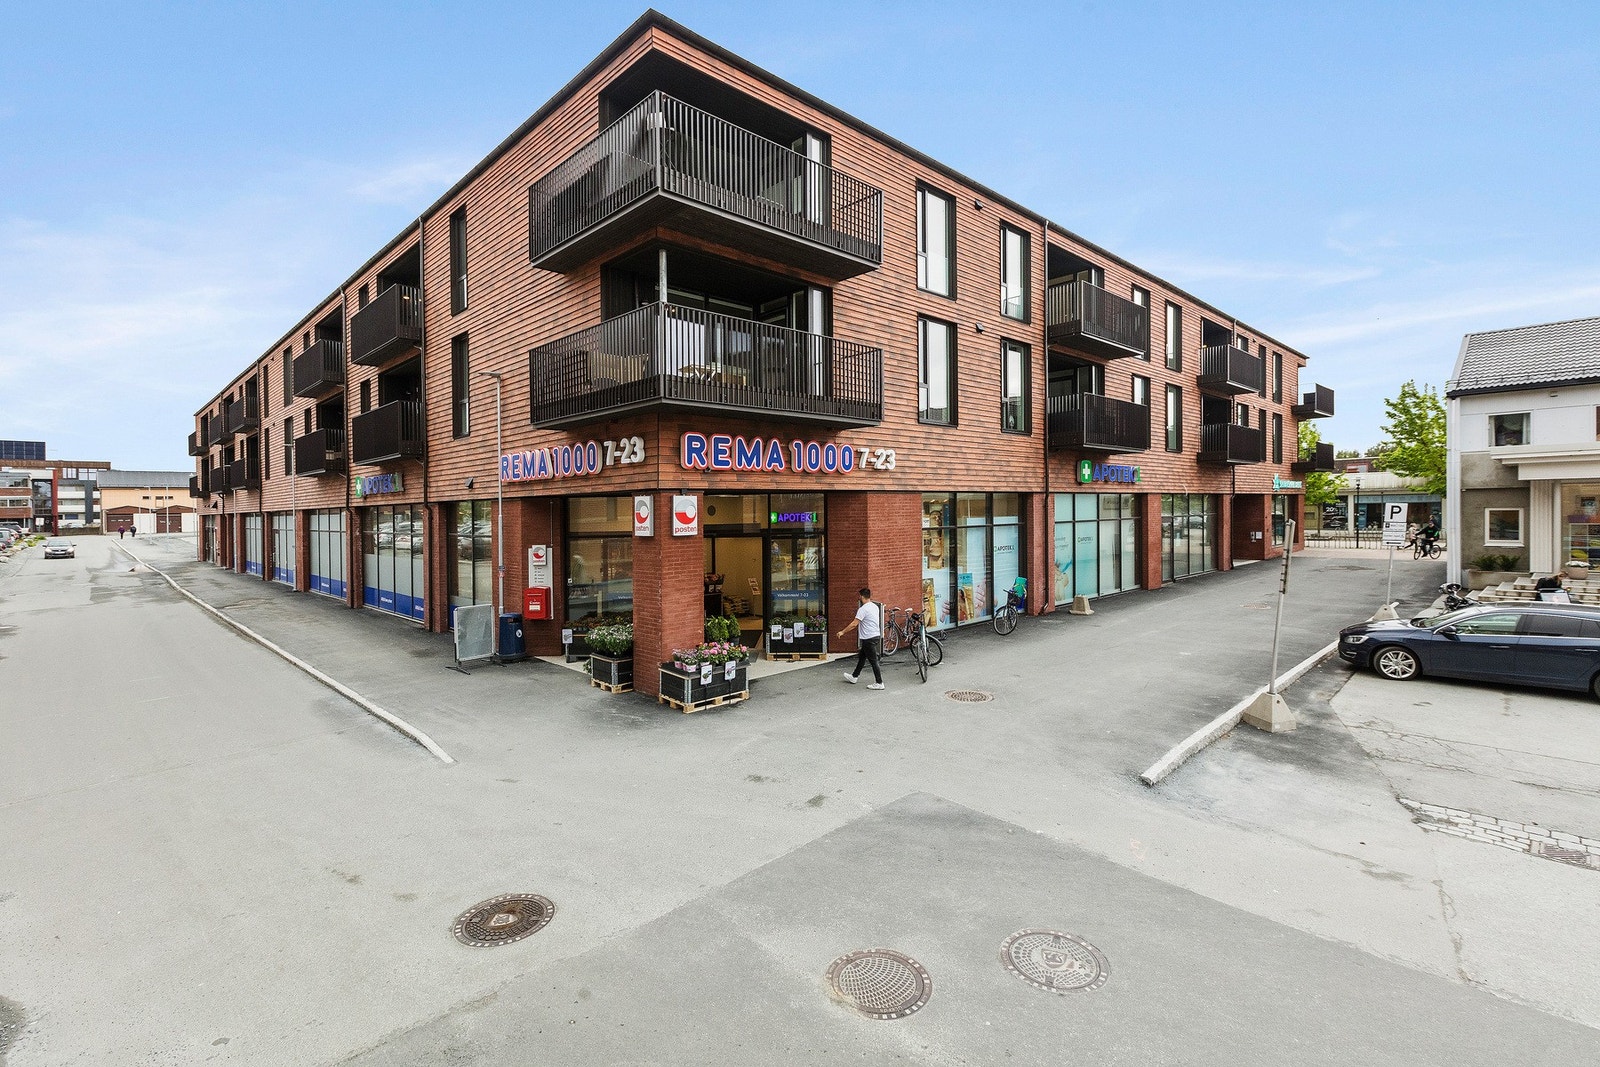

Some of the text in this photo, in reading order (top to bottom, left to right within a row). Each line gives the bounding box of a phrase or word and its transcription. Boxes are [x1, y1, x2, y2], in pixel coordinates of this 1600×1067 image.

[500, 436, 646, 482] REMA 1000 7-23
[680, 431, 896, 475] REMA 1000 7-23
[1092, 463, 1142, 483] APOTEK 1
[362, 473, 395, 496] APOTEK
[778, 511, 818, 523] APOTEK 1
[1389, 505, 1402, 520] P
[674, 526, 697, 534] posten
